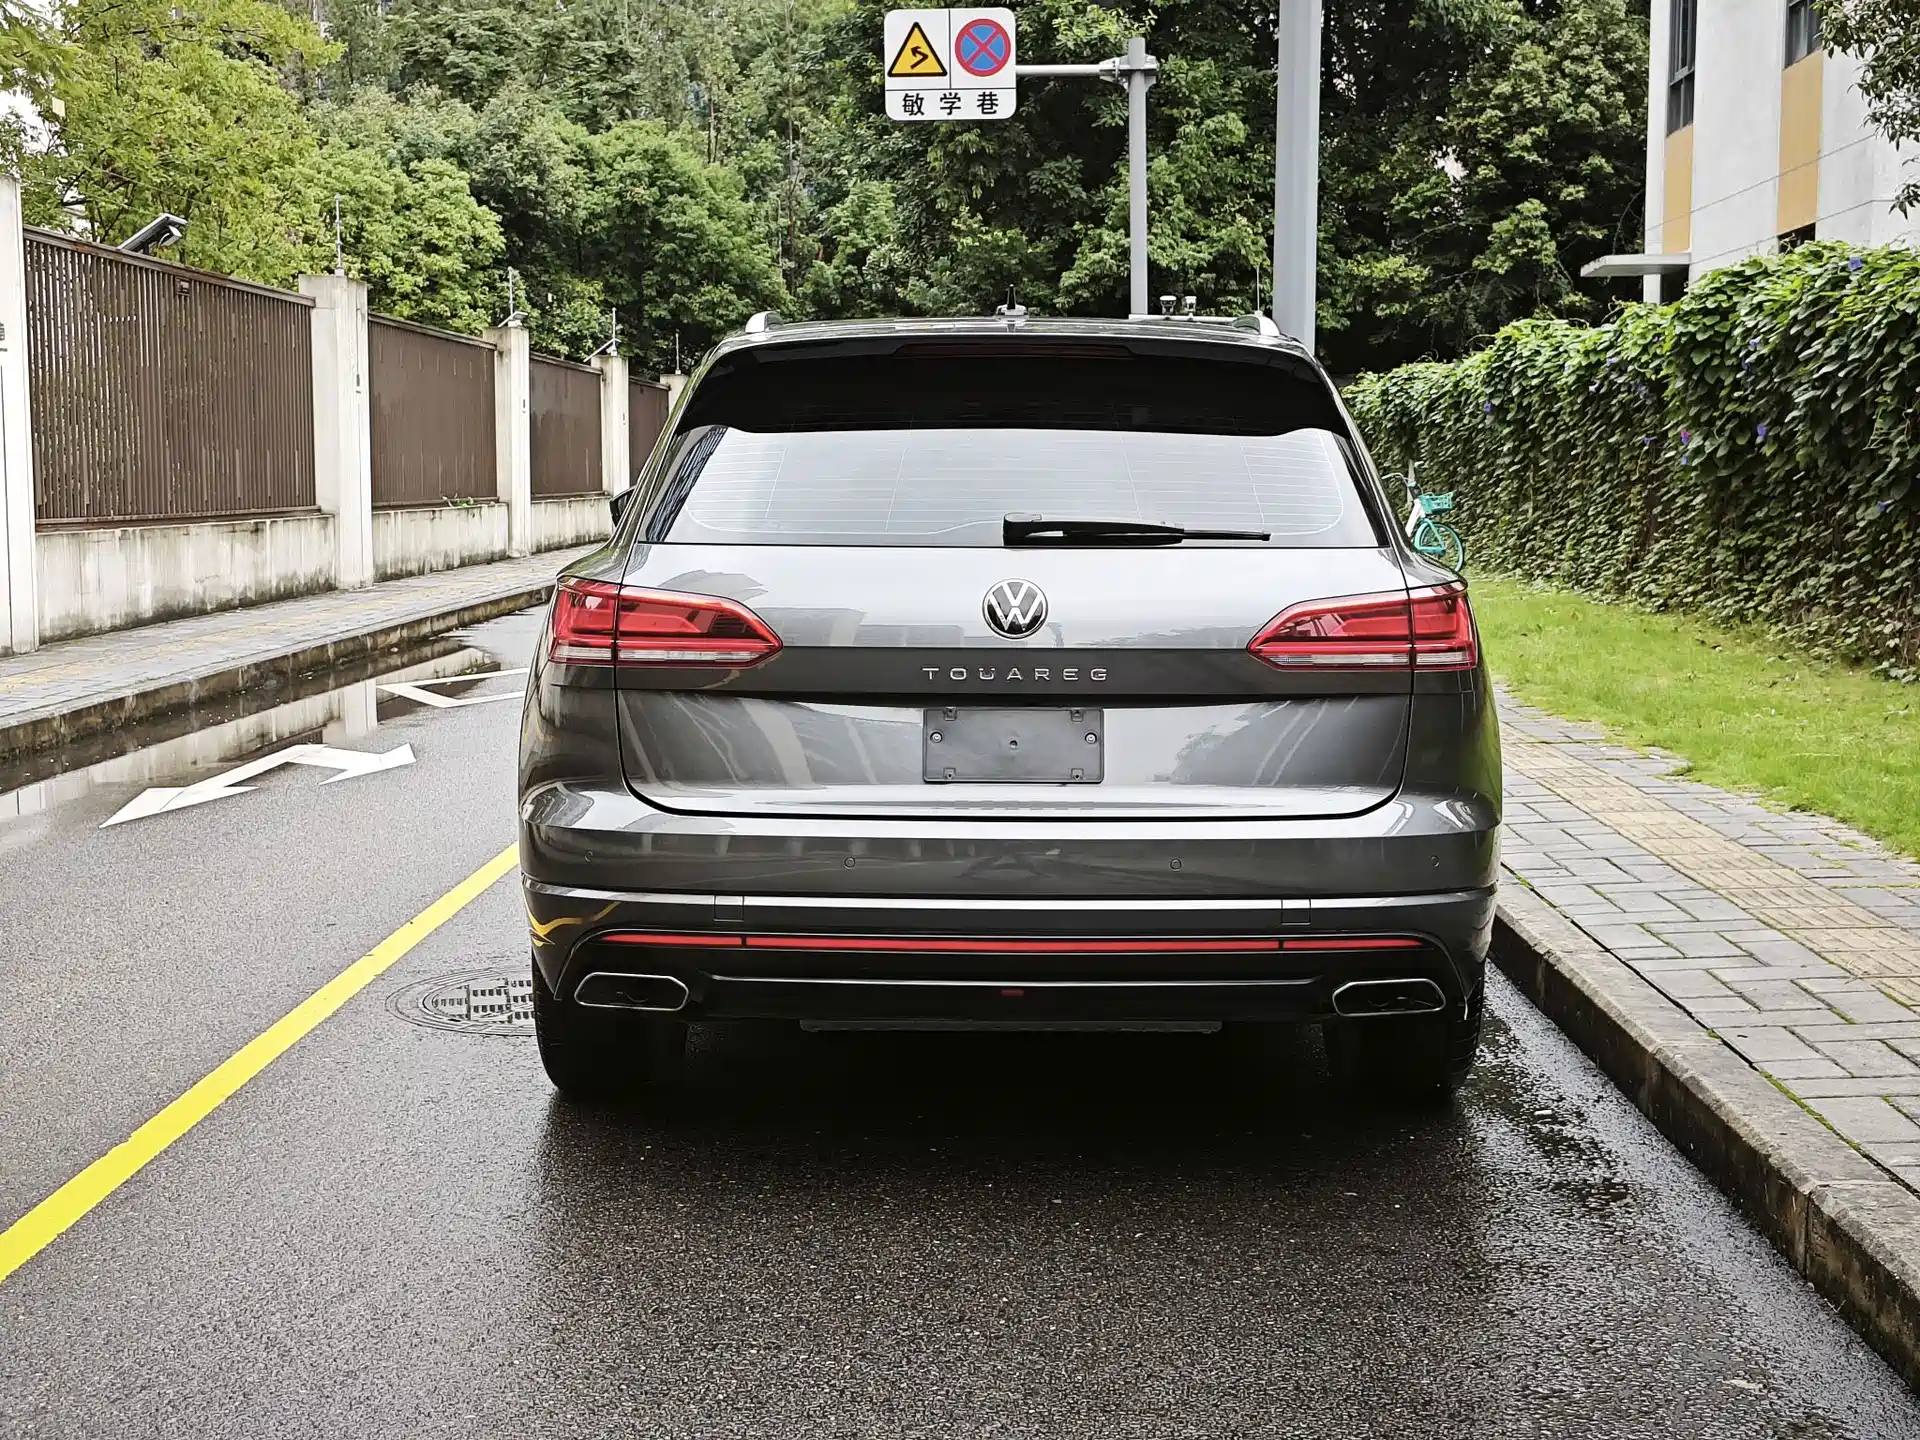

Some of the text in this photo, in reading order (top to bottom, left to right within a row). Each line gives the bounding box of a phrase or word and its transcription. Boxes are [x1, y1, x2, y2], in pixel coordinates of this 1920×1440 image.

[902, 91, 999, 116] 敏学巷
[983, 579, 1048, 639] VW
